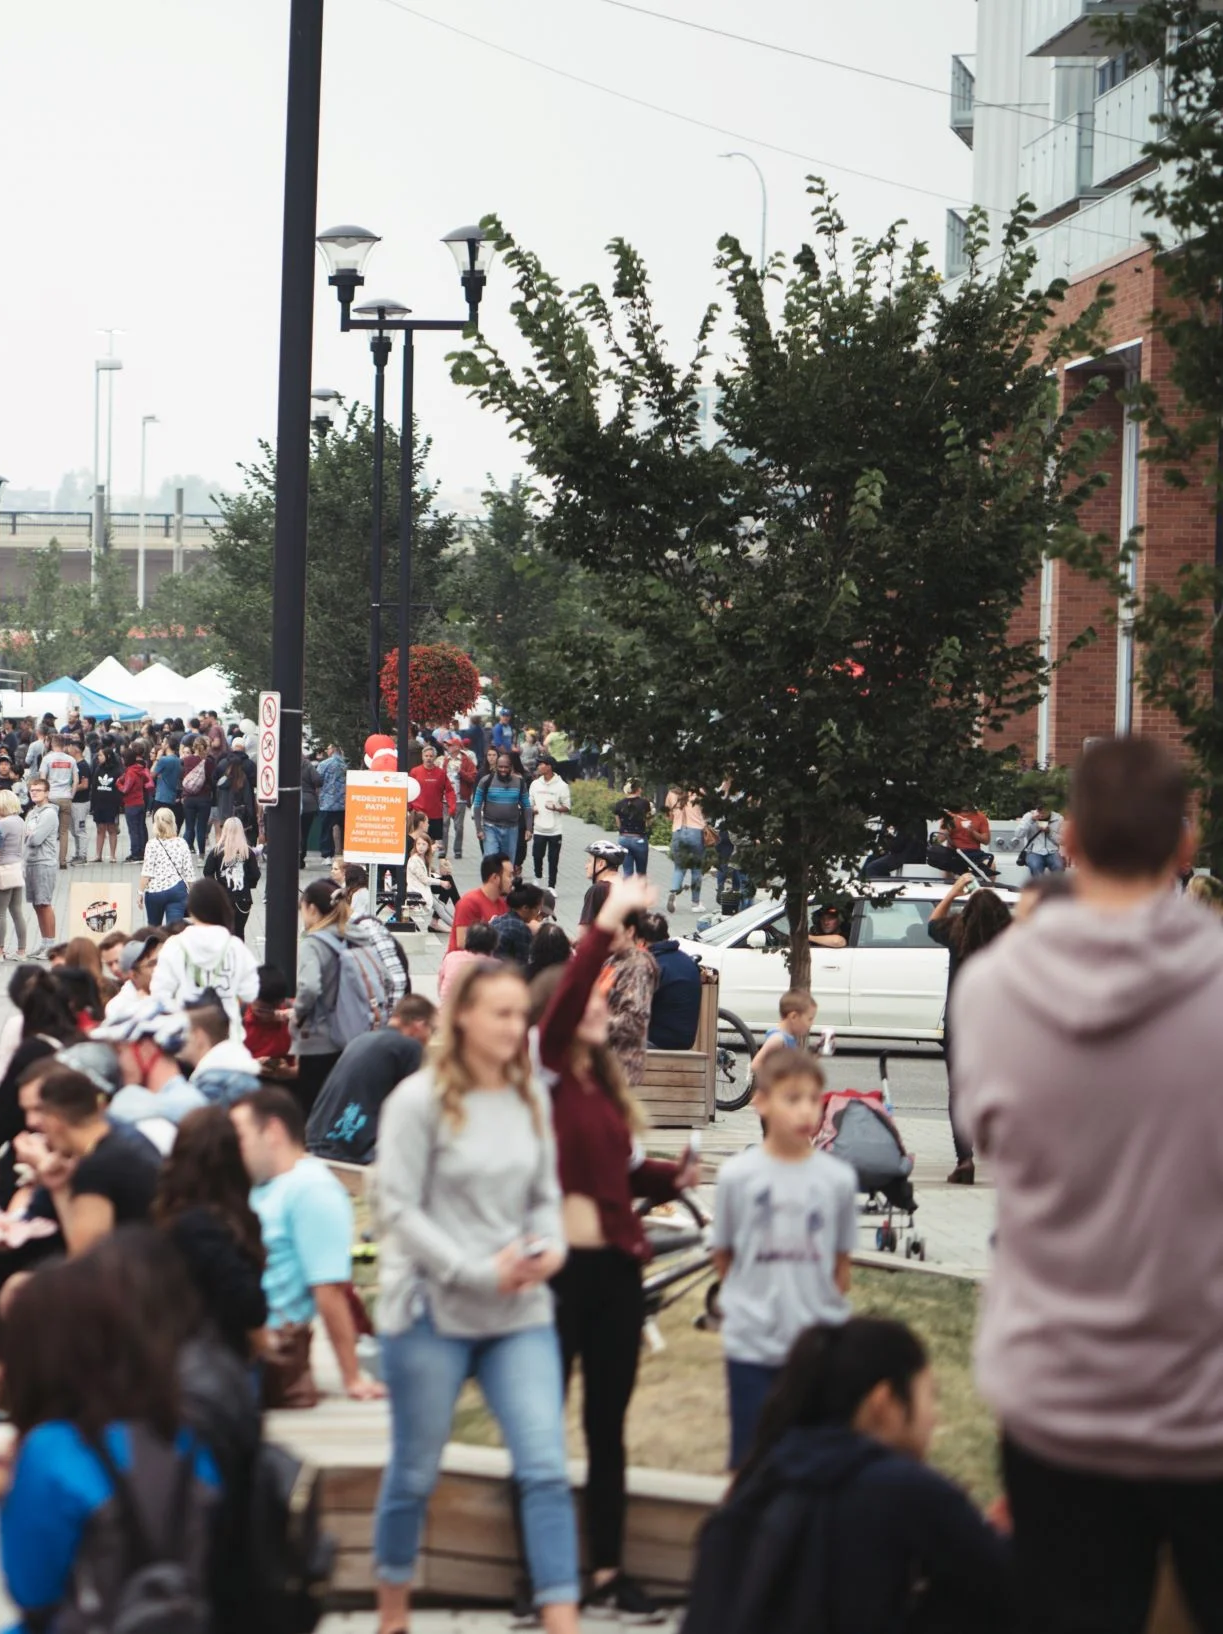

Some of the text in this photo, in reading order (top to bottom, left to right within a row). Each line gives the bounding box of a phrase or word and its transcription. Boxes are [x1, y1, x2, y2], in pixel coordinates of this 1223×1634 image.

[351, 794, 402, 804] PEDESTRIAN
[365, 803, 387, 811] PATH
[355, 814, 381, 822] ACCESS
[355, 822, 395, 830] EMERGENCY
[366, 830, 399, 838] SECURITY
[350, 836, 381, 844] VEHICLES
